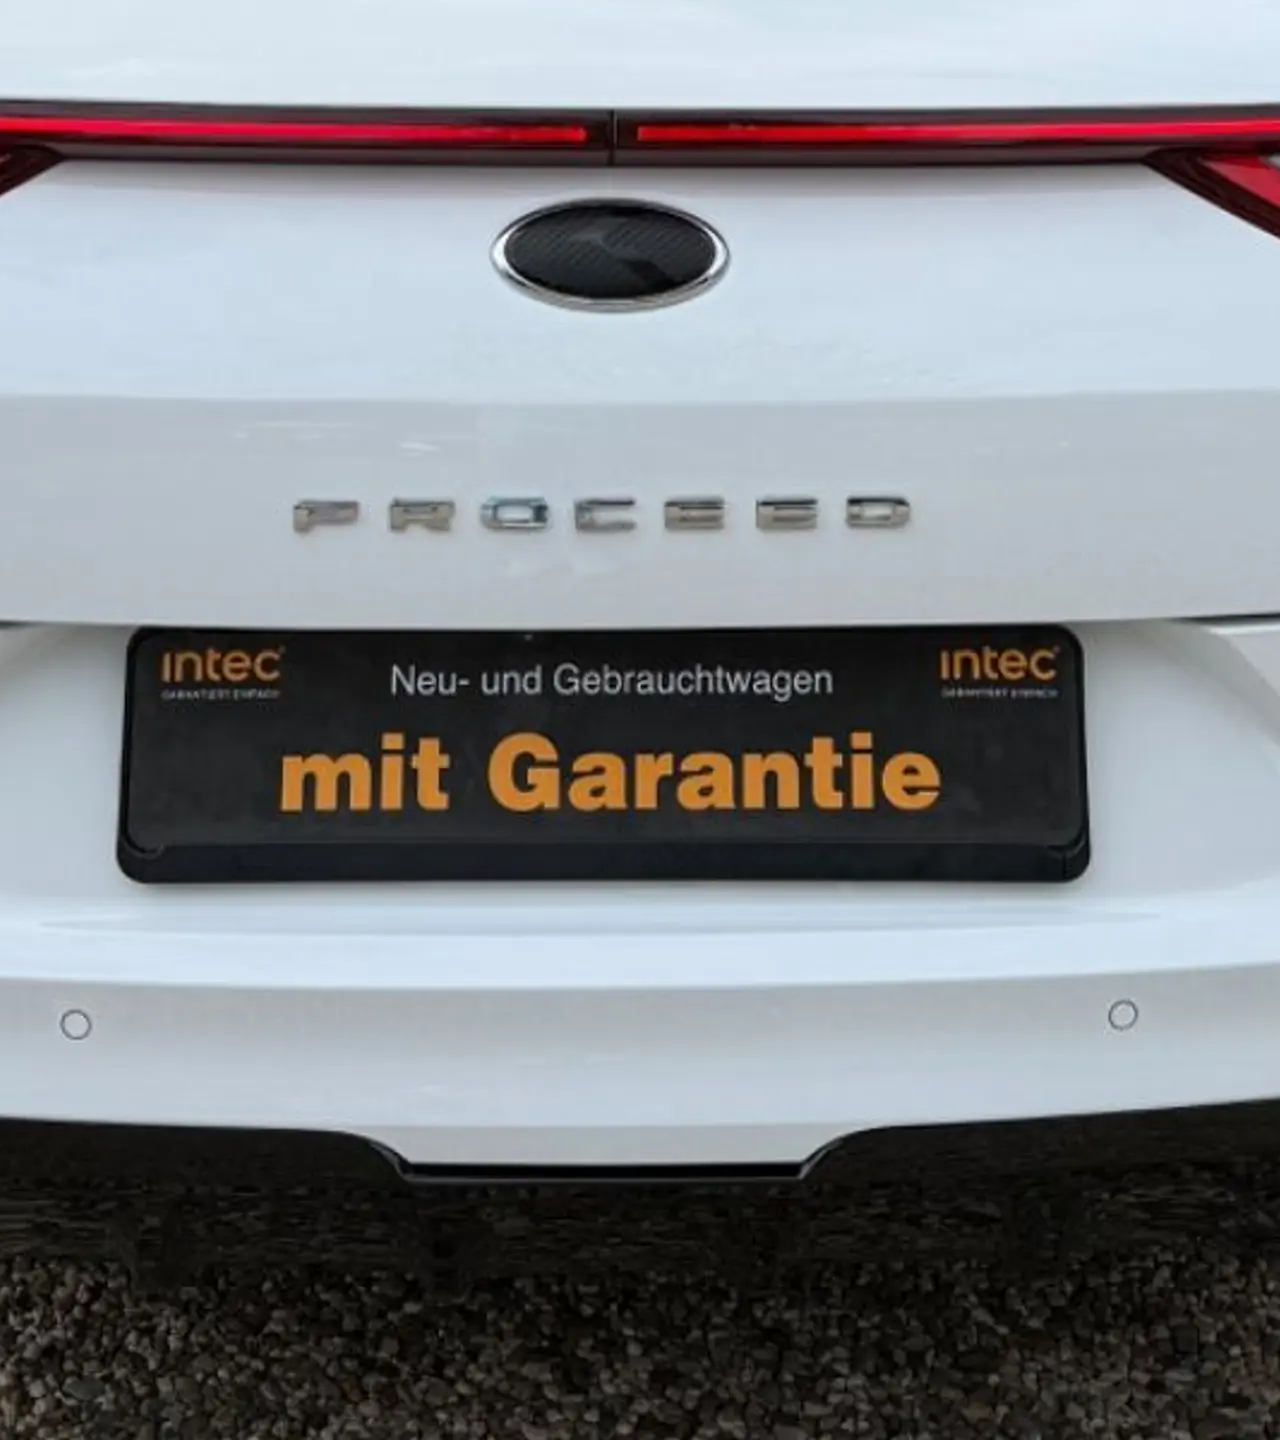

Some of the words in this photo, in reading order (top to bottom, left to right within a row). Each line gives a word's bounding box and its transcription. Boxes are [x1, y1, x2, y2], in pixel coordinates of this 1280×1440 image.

[293, 497, 912, 533] PROCEED
[391, 663, 470, 696] Neu-
[481, 664, 543, 696] und
[552, 662, 834, 703] Gebrauchtwagen
[280, 732, 450, 812] mit
[487, 731, 942, 812] Garantie
